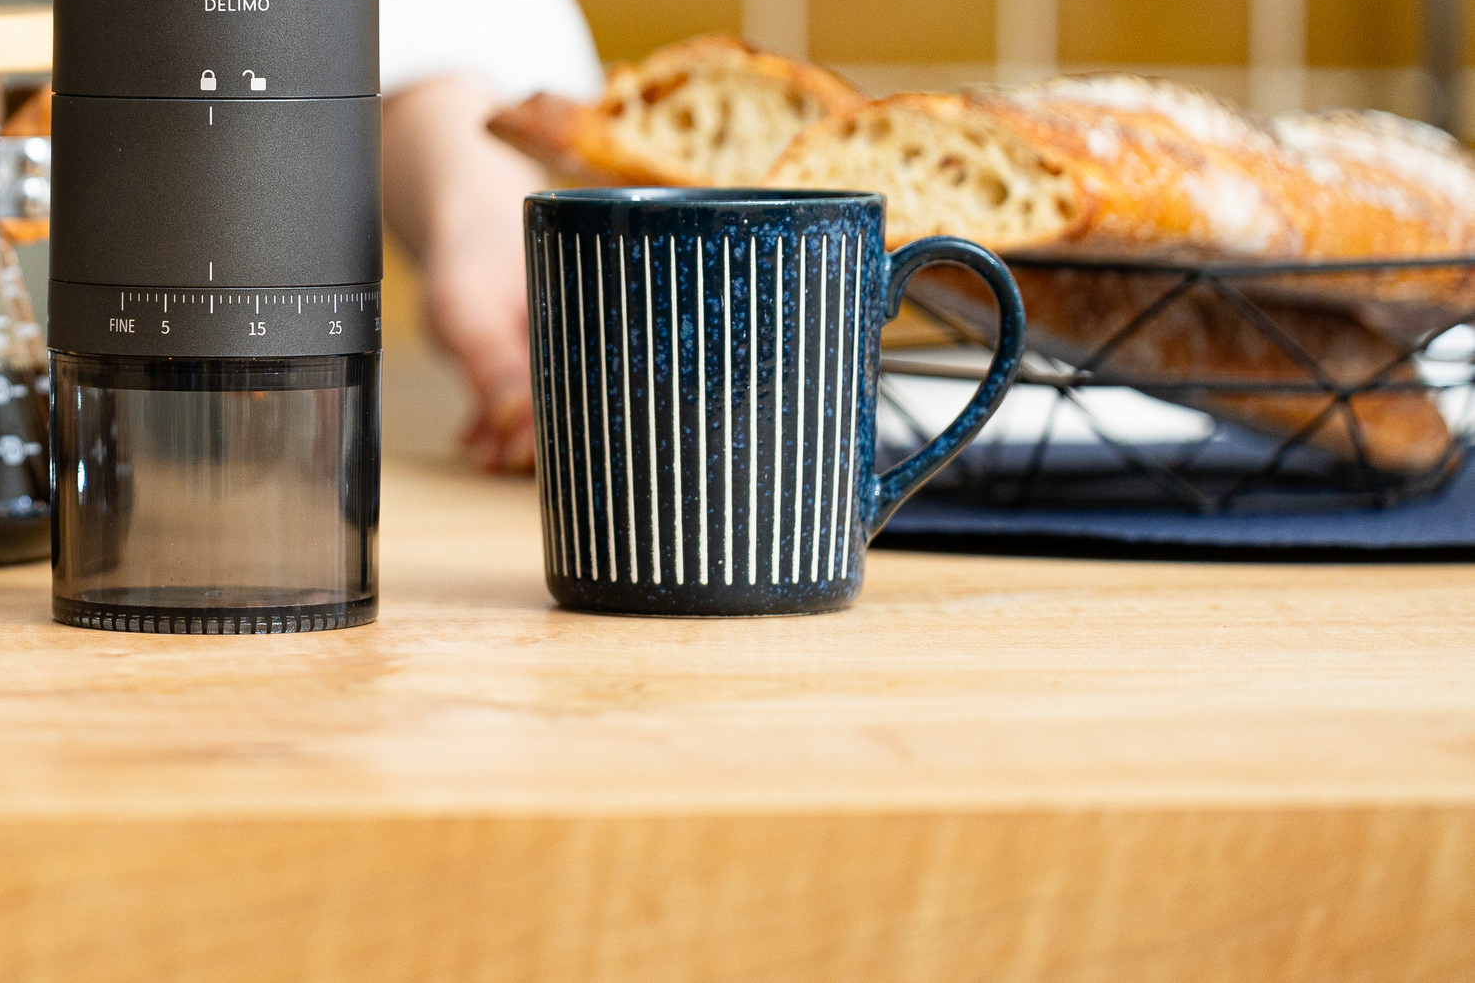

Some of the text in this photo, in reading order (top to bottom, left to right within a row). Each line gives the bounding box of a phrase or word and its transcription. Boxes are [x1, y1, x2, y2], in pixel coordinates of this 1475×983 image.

[109, 318, 136, 333] FINE
[160, 320, 171, 335] 5
[248, 321, 267, 336] 15
[328, 320, 343, 335] 25
